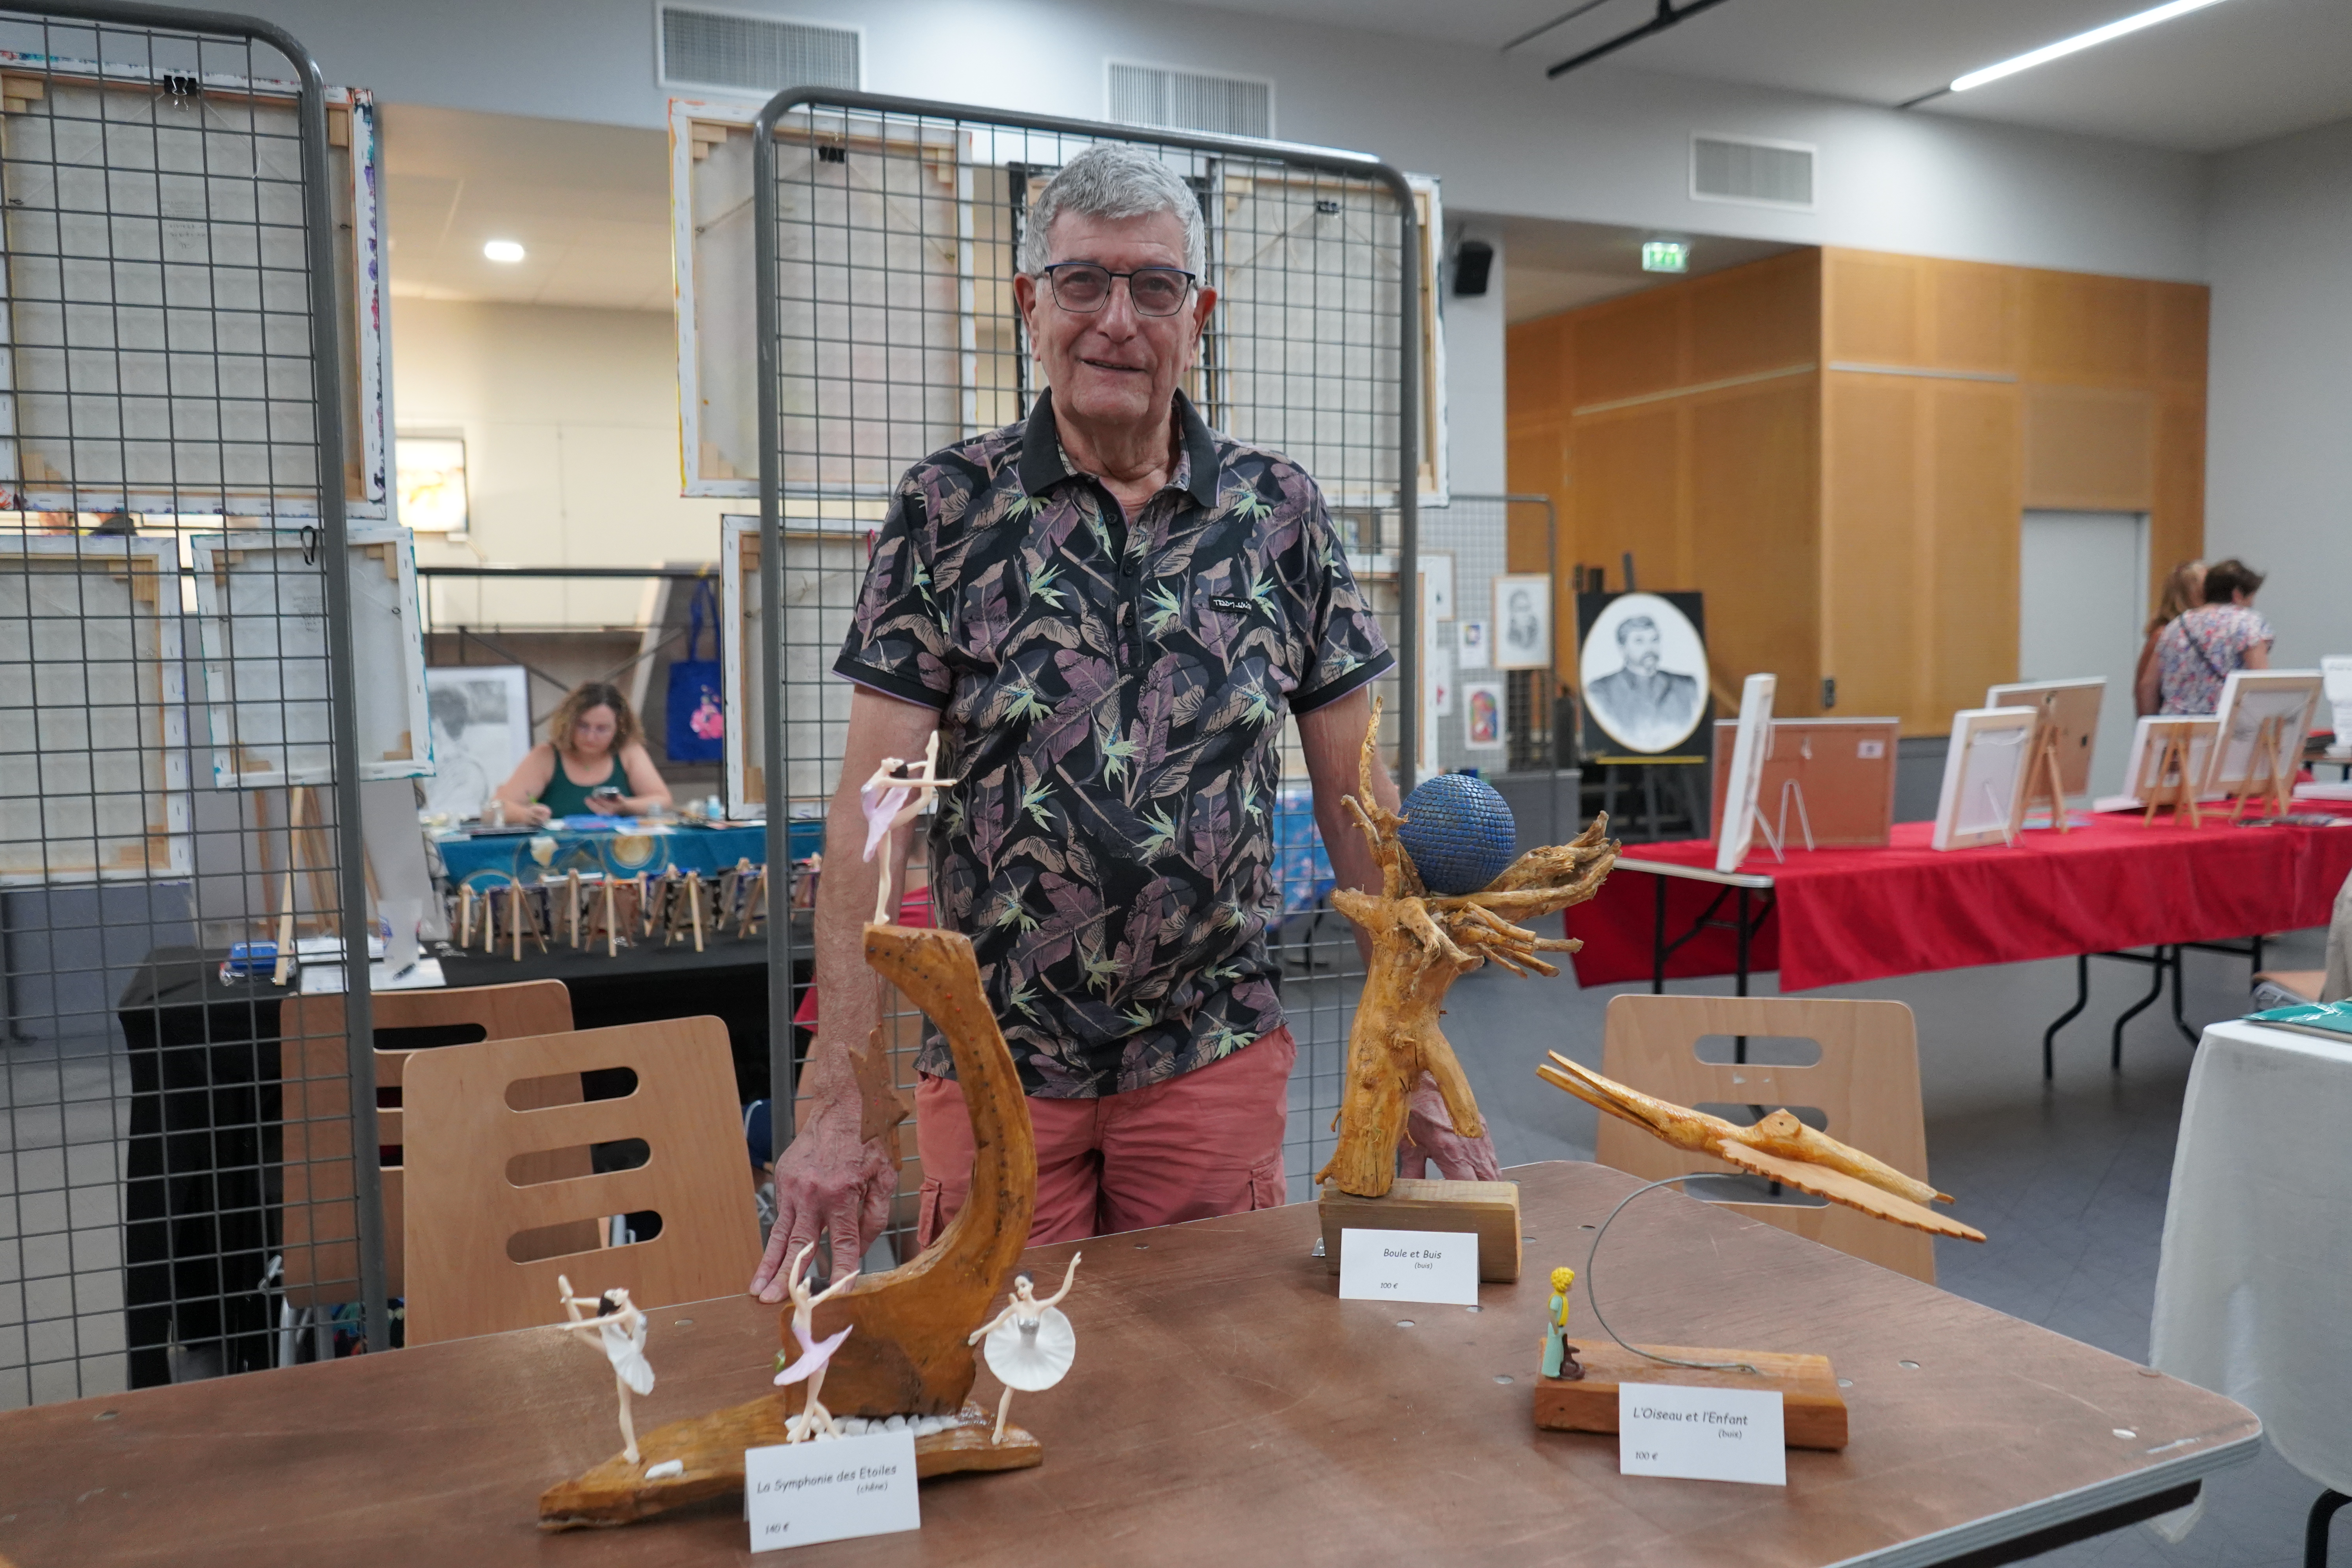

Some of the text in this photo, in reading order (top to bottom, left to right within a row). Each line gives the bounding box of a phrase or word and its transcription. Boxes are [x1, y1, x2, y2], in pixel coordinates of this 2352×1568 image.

[1213, 599, 1234, 608] TEDDY
[1384, 1249, 1407, 1258] Boule
[1423, 1250, 1441, 1259] Buis
[1633, 1407, 1748, 1426] L'Oiseau et l'Enfant
[1636, 1452, 1650, 1460] 100
[757, 1465, 897, 1494] La Symphonie des Etoiles
[766, 1522, 789, 1534] 140 €
